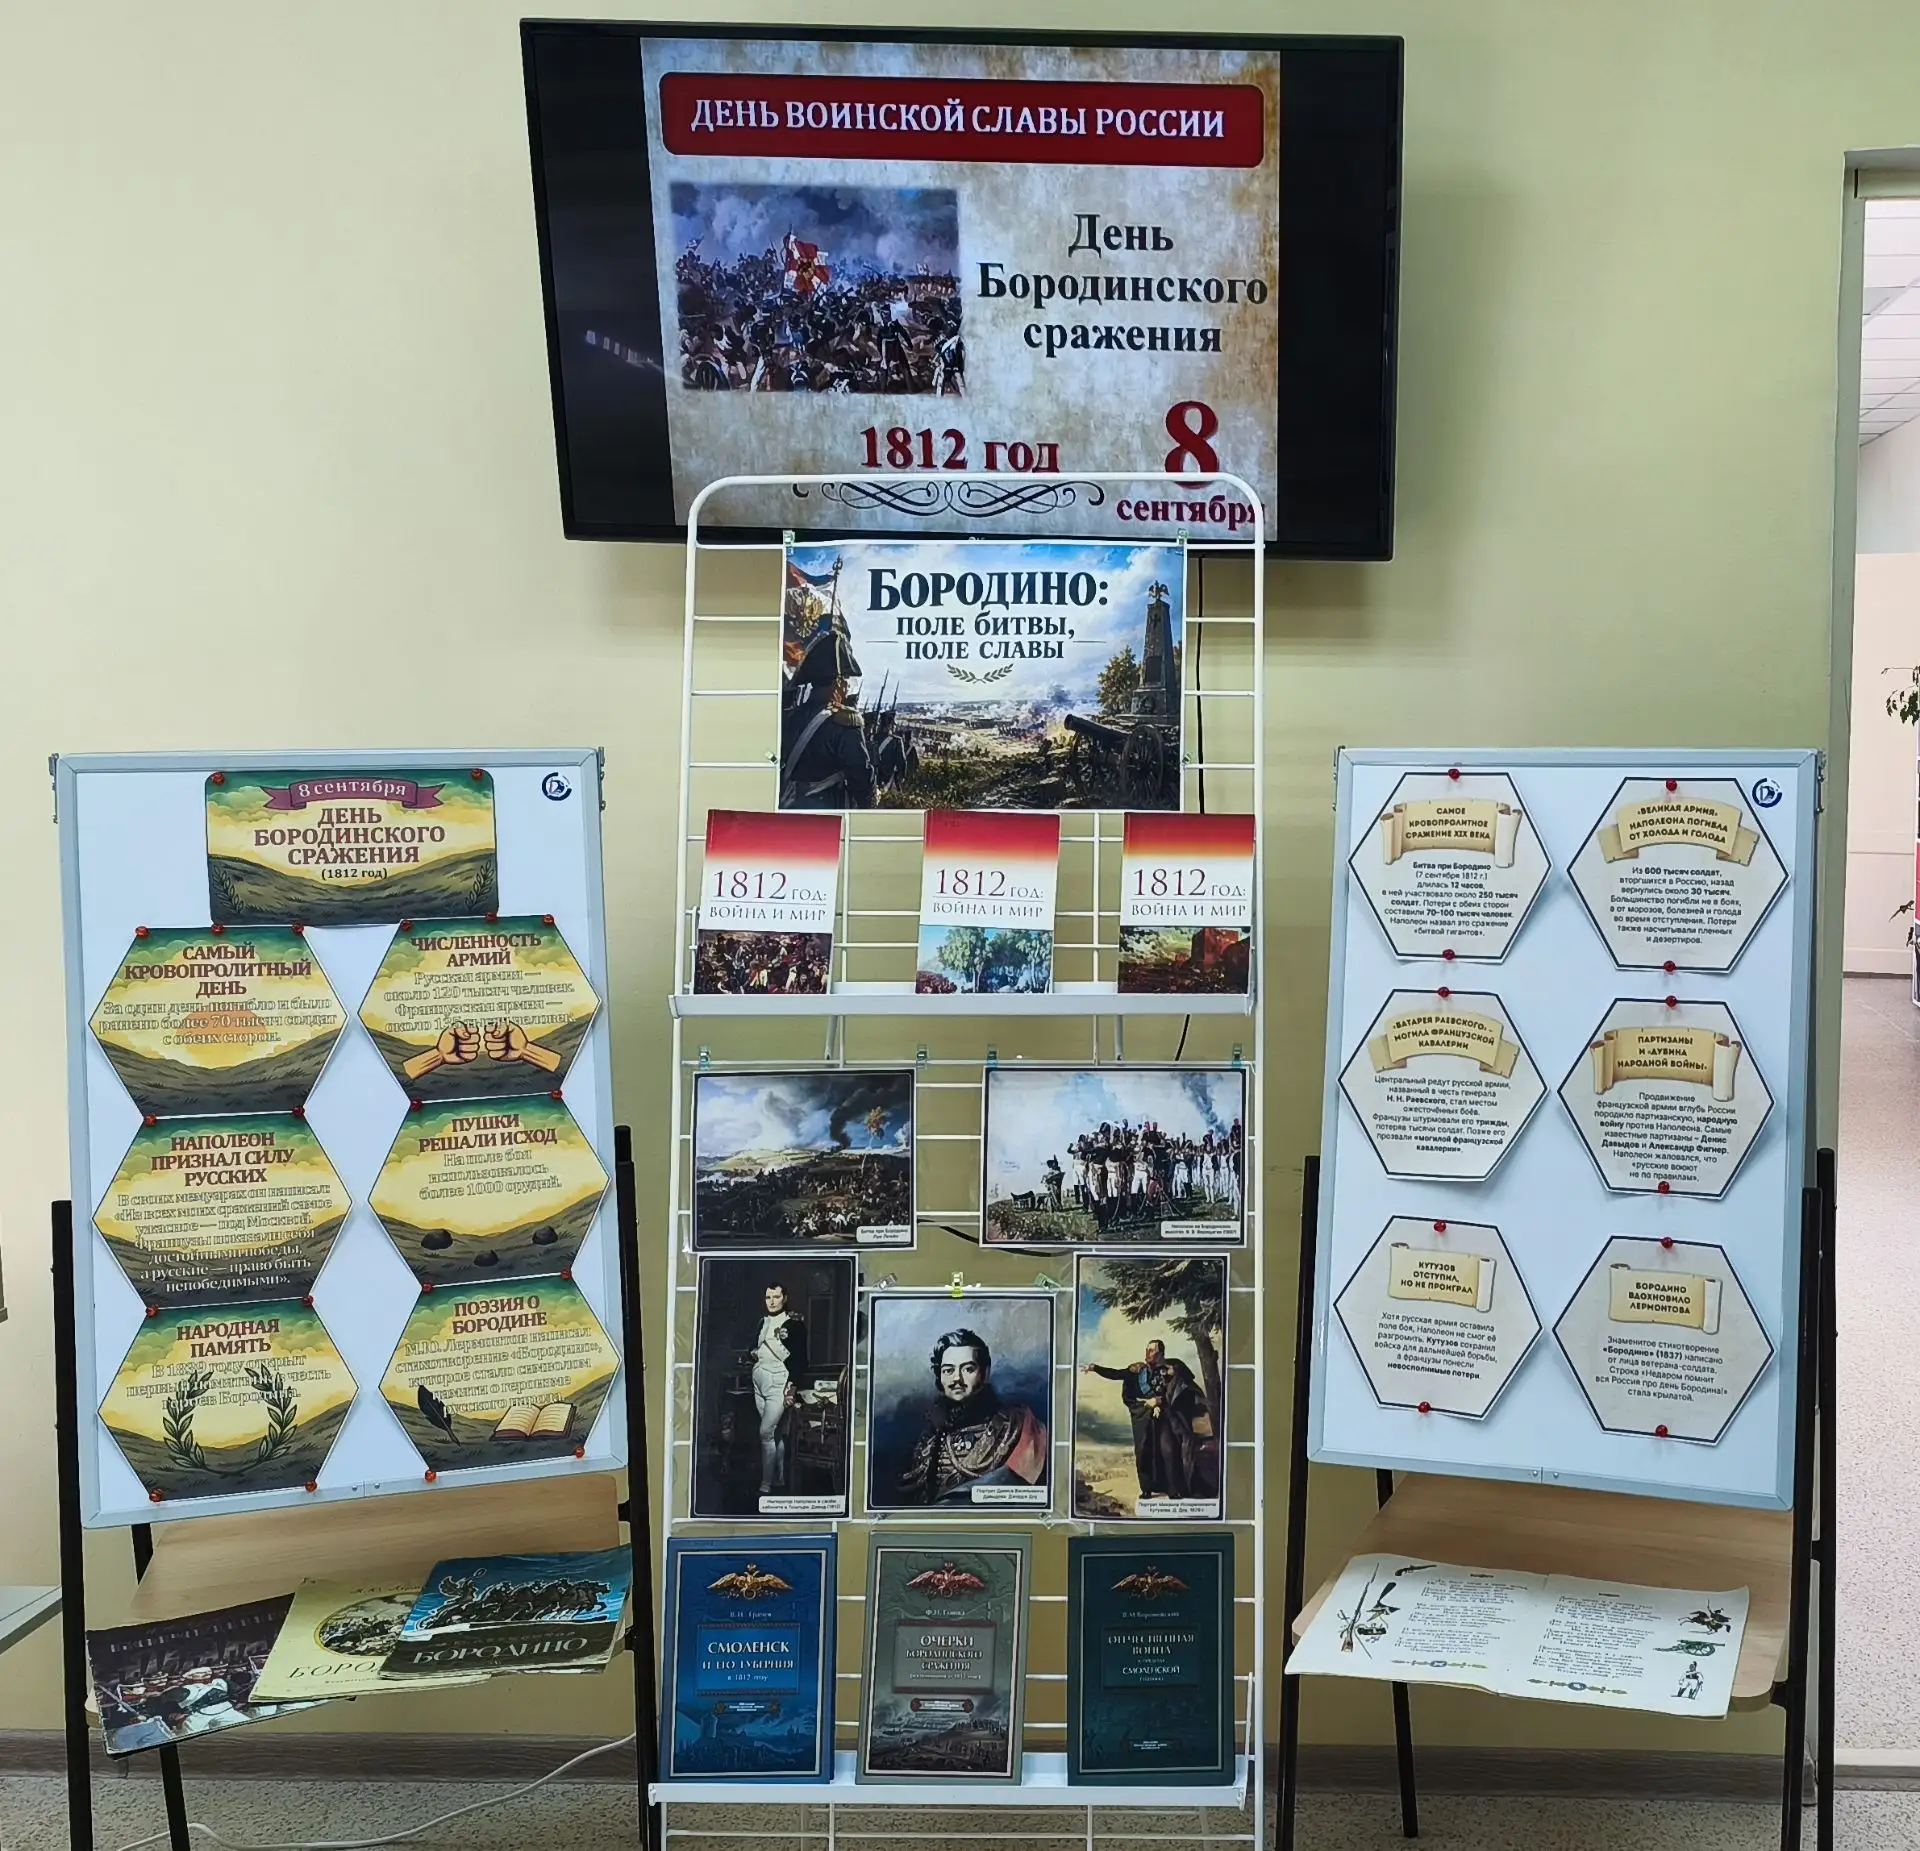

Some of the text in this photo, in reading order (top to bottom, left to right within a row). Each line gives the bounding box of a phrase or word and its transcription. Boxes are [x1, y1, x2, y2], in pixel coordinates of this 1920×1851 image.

[691, 98, 1225, 139] ДЕНЬ ВОИНСКОЙ СЛАВЫ РОССИИ
[1067, 213, 1174, 258] День
[976, 262, 1268, 309] Бородинского
[1023, 322, 1222, 358] сражения
[860, 426, 1060, 473] 1812 год
[1164, 400, 1220, 490] 8
[866, 568, 1109, 611] БОРОДИНО:
[905, 641, 1064, 661] ПОЛЕ СЛАВЫ
[298, 779, 407, 798] 8 сентября
[318, 807, 383, 827] ДЕНЬ
[1436, 807, 1466, 815] САМОЕ
[1409, 819, 1488, 828] КРОВОПРОЛИТНОЕ
[1629, 817, 1728, 832] НАПОЛЕОНА ПОГИБЛА
[254, 826, 446, 849] БОРОДИНСКОГО
[1405, 830, 1452, 839] СРАЖЕНИЕ
[1469, 831, 1491, 840] ВЕКА
[1629, 828, 1726, 843] ОТ ХОЛОДА И ГОЛОДА
[288, 846, 420, 866] СРАЖЕНИЯ
[321, 867, 388, 881] (1812 год)
[934, 868, 1006, 898] 1812
[1133, 868, 1207, 898] 1812
[713, 870, 788, 900] 1812
[709, 904, 826, 921] ВОЙНА И МИР
[932, 900, 1044, 919] ВОЙНА И МИР
[1131, 901, 1246, 919] ВОЙНА И МИР
[182, 941, 255, 960] САМЫЙ
[411, 933, 541, 952] ЧИСЛЕННОСТЬ
[446, 948, 511, 967] АРМИЙ
[124, 958, 311, 980] КРОВОПРОЛИТНЫЙ
[196, 981, 247, 998] ДЕНЬ
[1394, 1029, 1495, 1046] МОГИЛА ФРАНЦУЗСКОЙ
[1418, 1040, 1469, 1050] КАВАЛЕРИИ
[1637, 1036, 1693, 1045] ПАРТИЗАНЫ
[1617, 1058, 1668, 1068] НАРОДНОЙ
[451, 1114, 520, 1132] ПУШКИ
[171, 1131, 275, 1151] НАПОЛЕОН
[419, 1128, 557, 1153] РЕШАЛИ ИСХОД
[151, 1148, 295, 1171] ПРИЗНАЛ СИЛУ
[184, 1168, 268, 1187] РУССКИХ
[1418, 1261, 1455, 1272] КУТУЗОВ
[1400, 1279, 1473, 1294] НО НЕ ПРОИГРАЛ
[1635, 1282, 1686, 1294] БОРОДИНО
[454, 1295, 540, 1317] ПОЭЗИЯ О
[1628, 1291, 1690, 1304] ВДОХНОВИЛО
[1629, 1302, 1690, 1314] ЛЕРМОНТОВА
[177, 1318, 281, 1341] НАРОДНАЯ
[452, 1312, 547, 1335] БОРОДИНЕ
[190, 1338, 272, 1359] ПАМЯТЬ
[708, 1641, 789, 1654] СМОЛЕНСК
[920, 1635, 974, 1646] ОЧЕРКИ
[413, 1637, 589, 1665] БОРОДИНО
